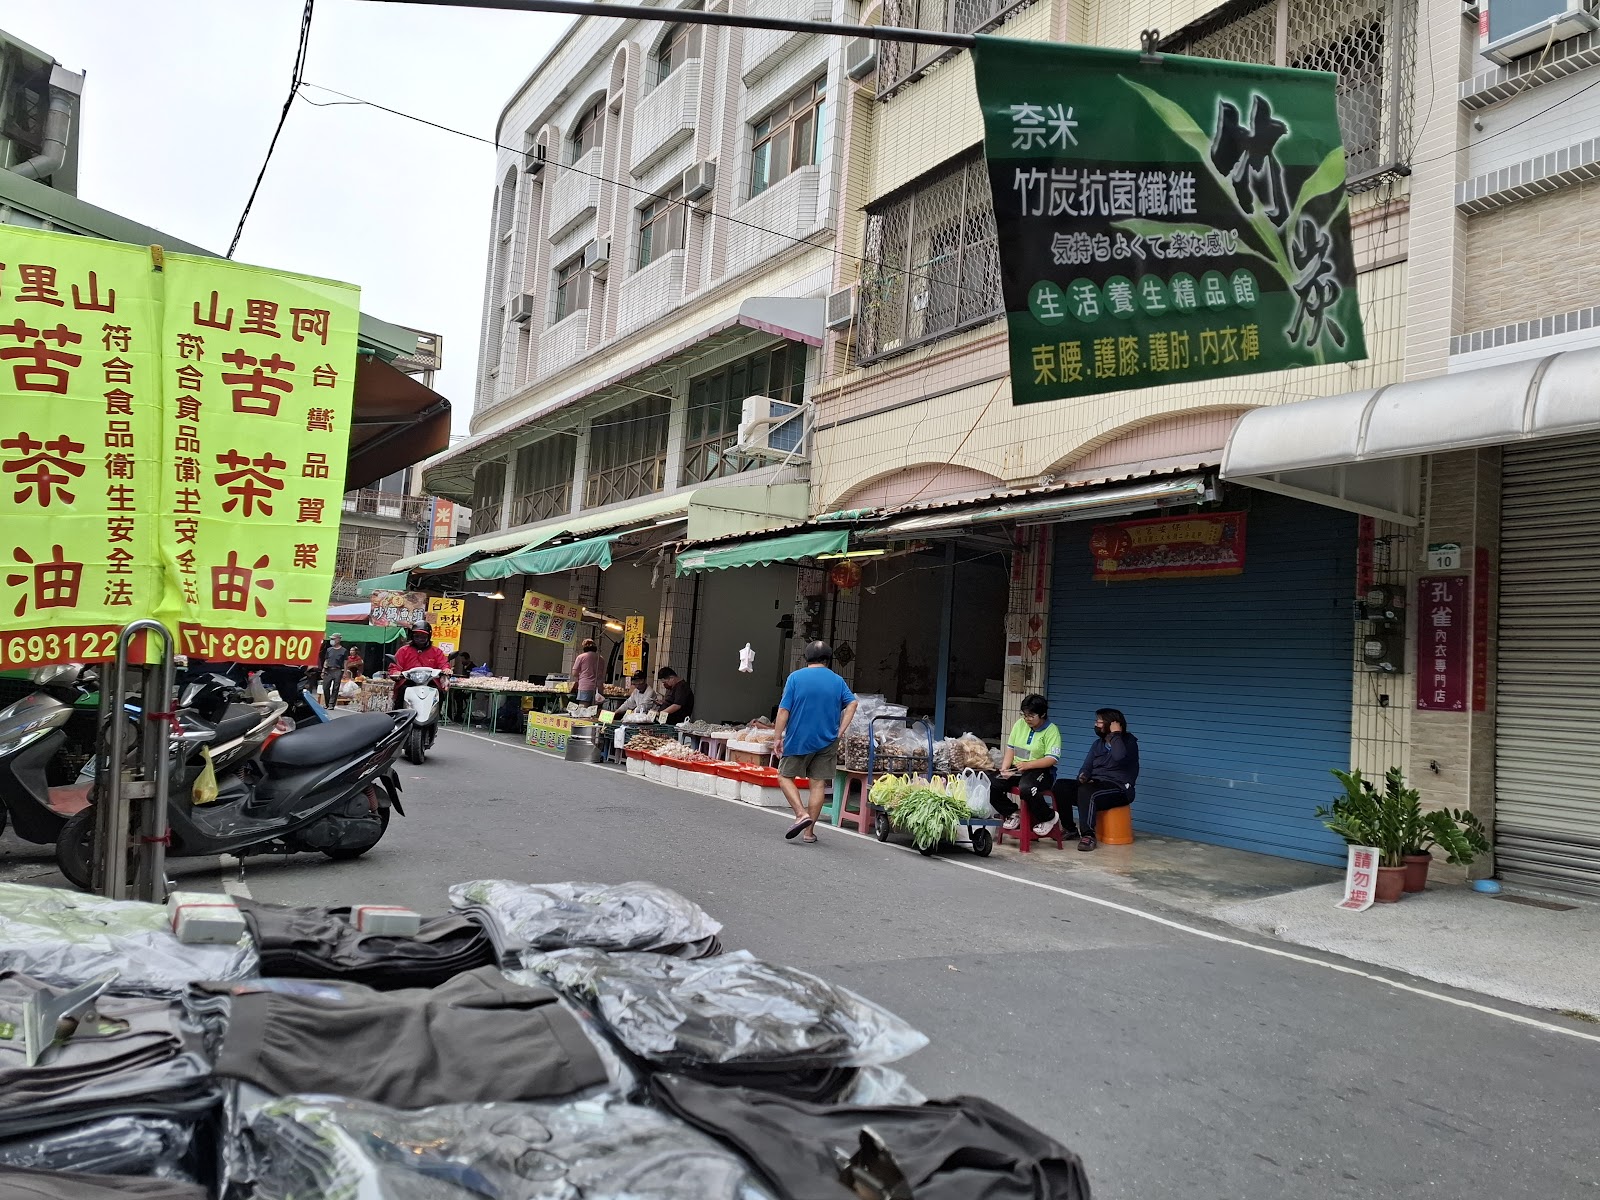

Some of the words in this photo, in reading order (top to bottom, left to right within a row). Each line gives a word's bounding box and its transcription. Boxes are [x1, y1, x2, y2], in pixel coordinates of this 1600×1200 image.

[1009, 102, 1079, 151] 奈米
[1012, 166, 1198, 219] 竹炭抗菌纖維
[1210, 91, 1347, 349] 竹炭
[0, 262, 116, 314] 里山
[1036, 275, 1256, 320] 生活養生精品館
[0, 318, 86, 618] 苦茶油
[101, 322, 135, 607] 符合食品衛生安全法
[1436, 556, 1452, 567] 10
[530, 596, 578, 619] 專業蛋品
[0, 631, 137, 666] 693122
